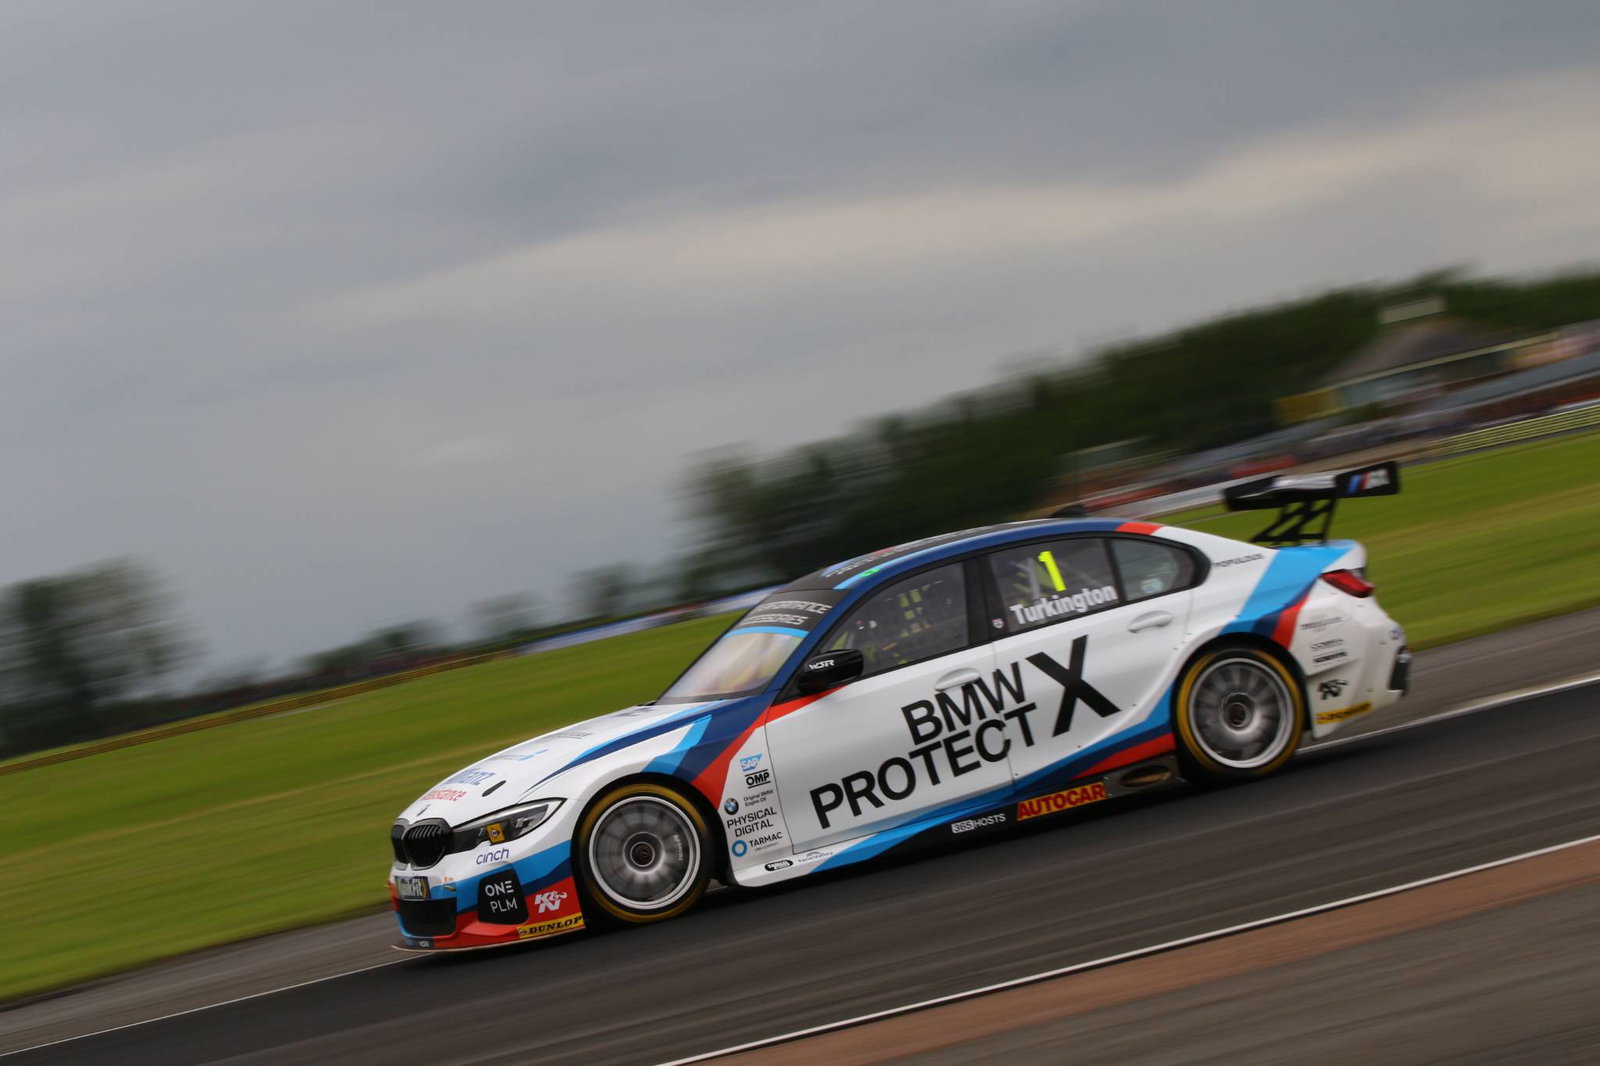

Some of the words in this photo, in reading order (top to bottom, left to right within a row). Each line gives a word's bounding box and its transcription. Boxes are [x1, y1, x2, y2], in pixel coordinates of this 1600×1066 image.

[1037, 551, 1067, 592] 1
[1009, 585, 1118, 625] Turkington
[1025, 634, 1121, 737] X
[901, 661, 1027, 746] BMW
[741, 756, 760, 769] SAP
[809, 702, 1037, 829] PROTECT
[746, 771, 770, 786] OMP
[1017, 783, 1105, 819] AUTOCAR
[726, 806, 778, 829] PHYSICAL
[734, 818, 774, 837] DIGITAL
[749, 831, 783, 847] TARMAC
[476, 847, 510, 865] cinch
[485, 880, 515, 897] ONE
[490, 897, 518, 913] PLM
[534, 890, 568, 914] K&N
[528, 916, 583, 935] DUNLOP
